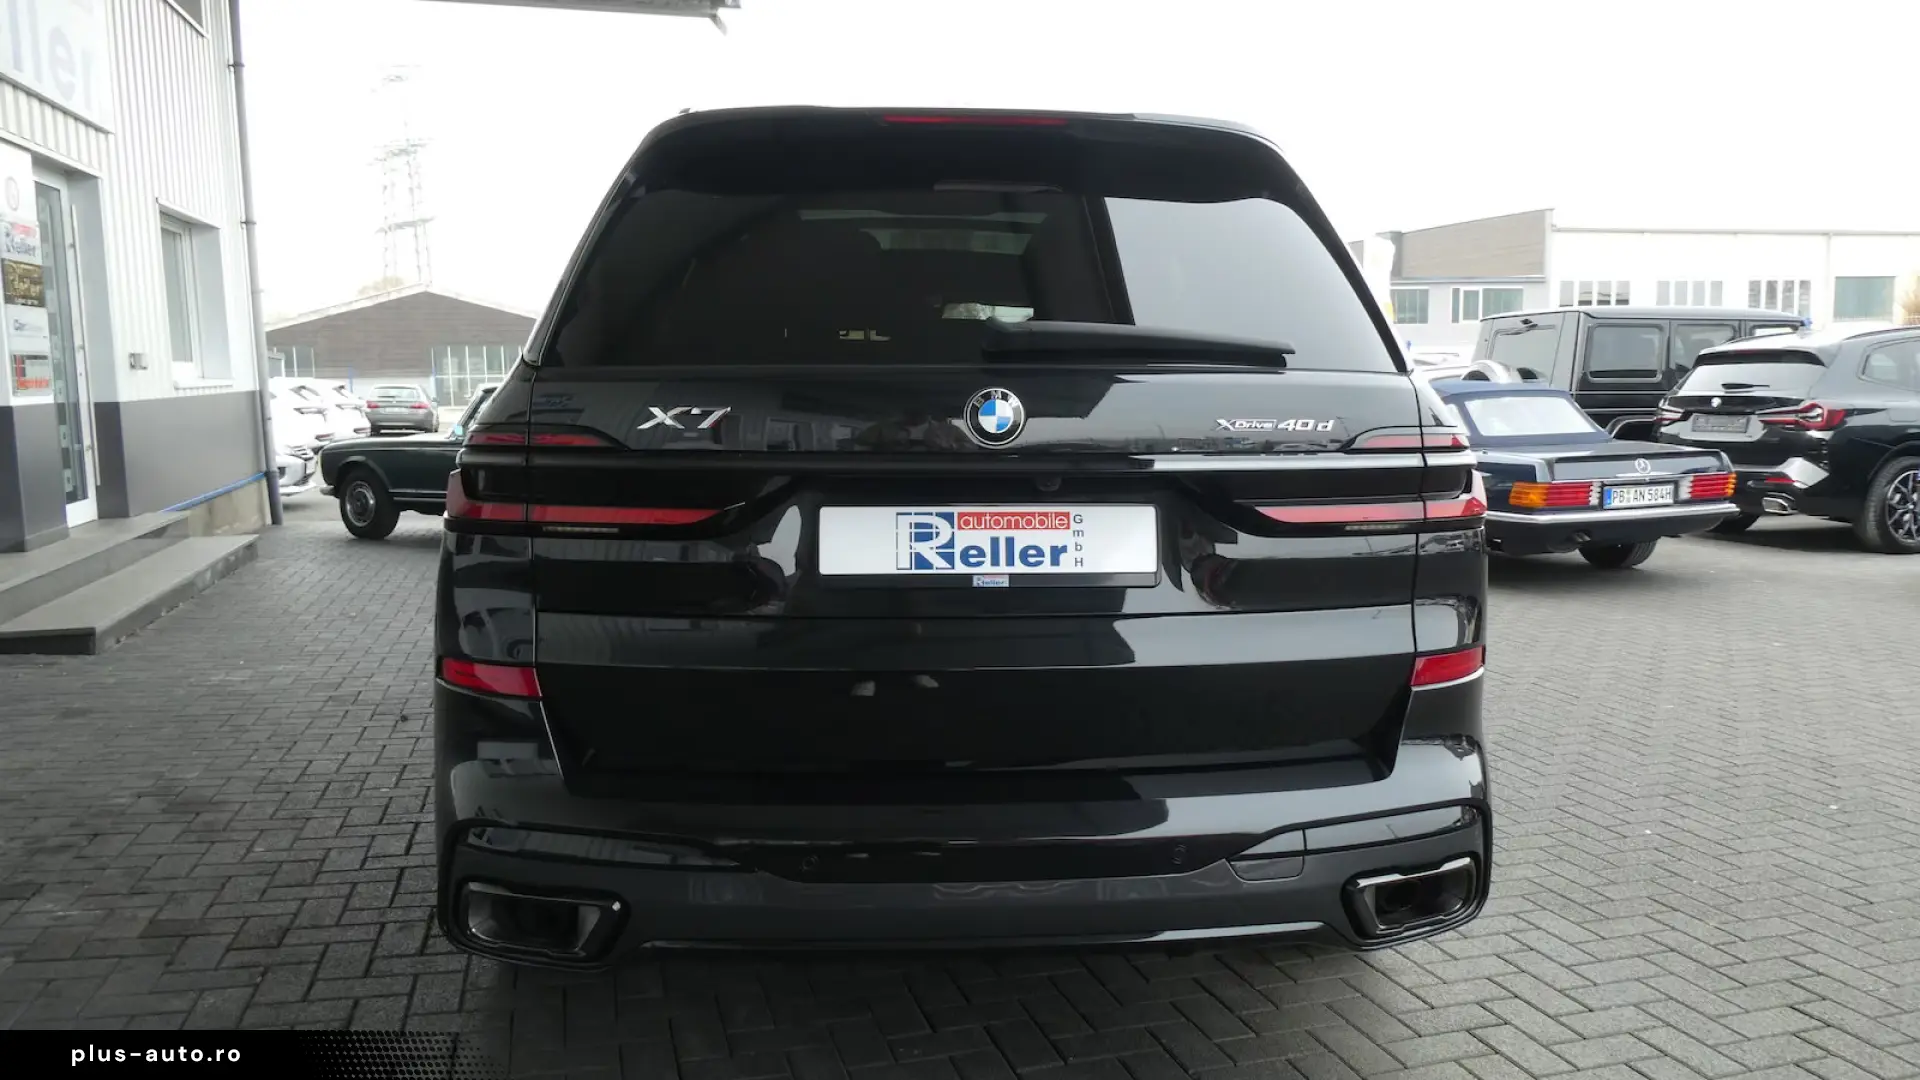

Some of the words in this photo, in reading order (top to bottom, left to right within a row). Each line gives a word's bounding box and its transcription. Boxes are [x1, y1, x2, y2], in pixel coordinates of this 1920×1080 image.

[972, 389, 1020, 408] BMW
[637, 406, 731, 429] X7
[960, 512, 1068, 529] automobile
[896, 512, 1068, 570] Reller
